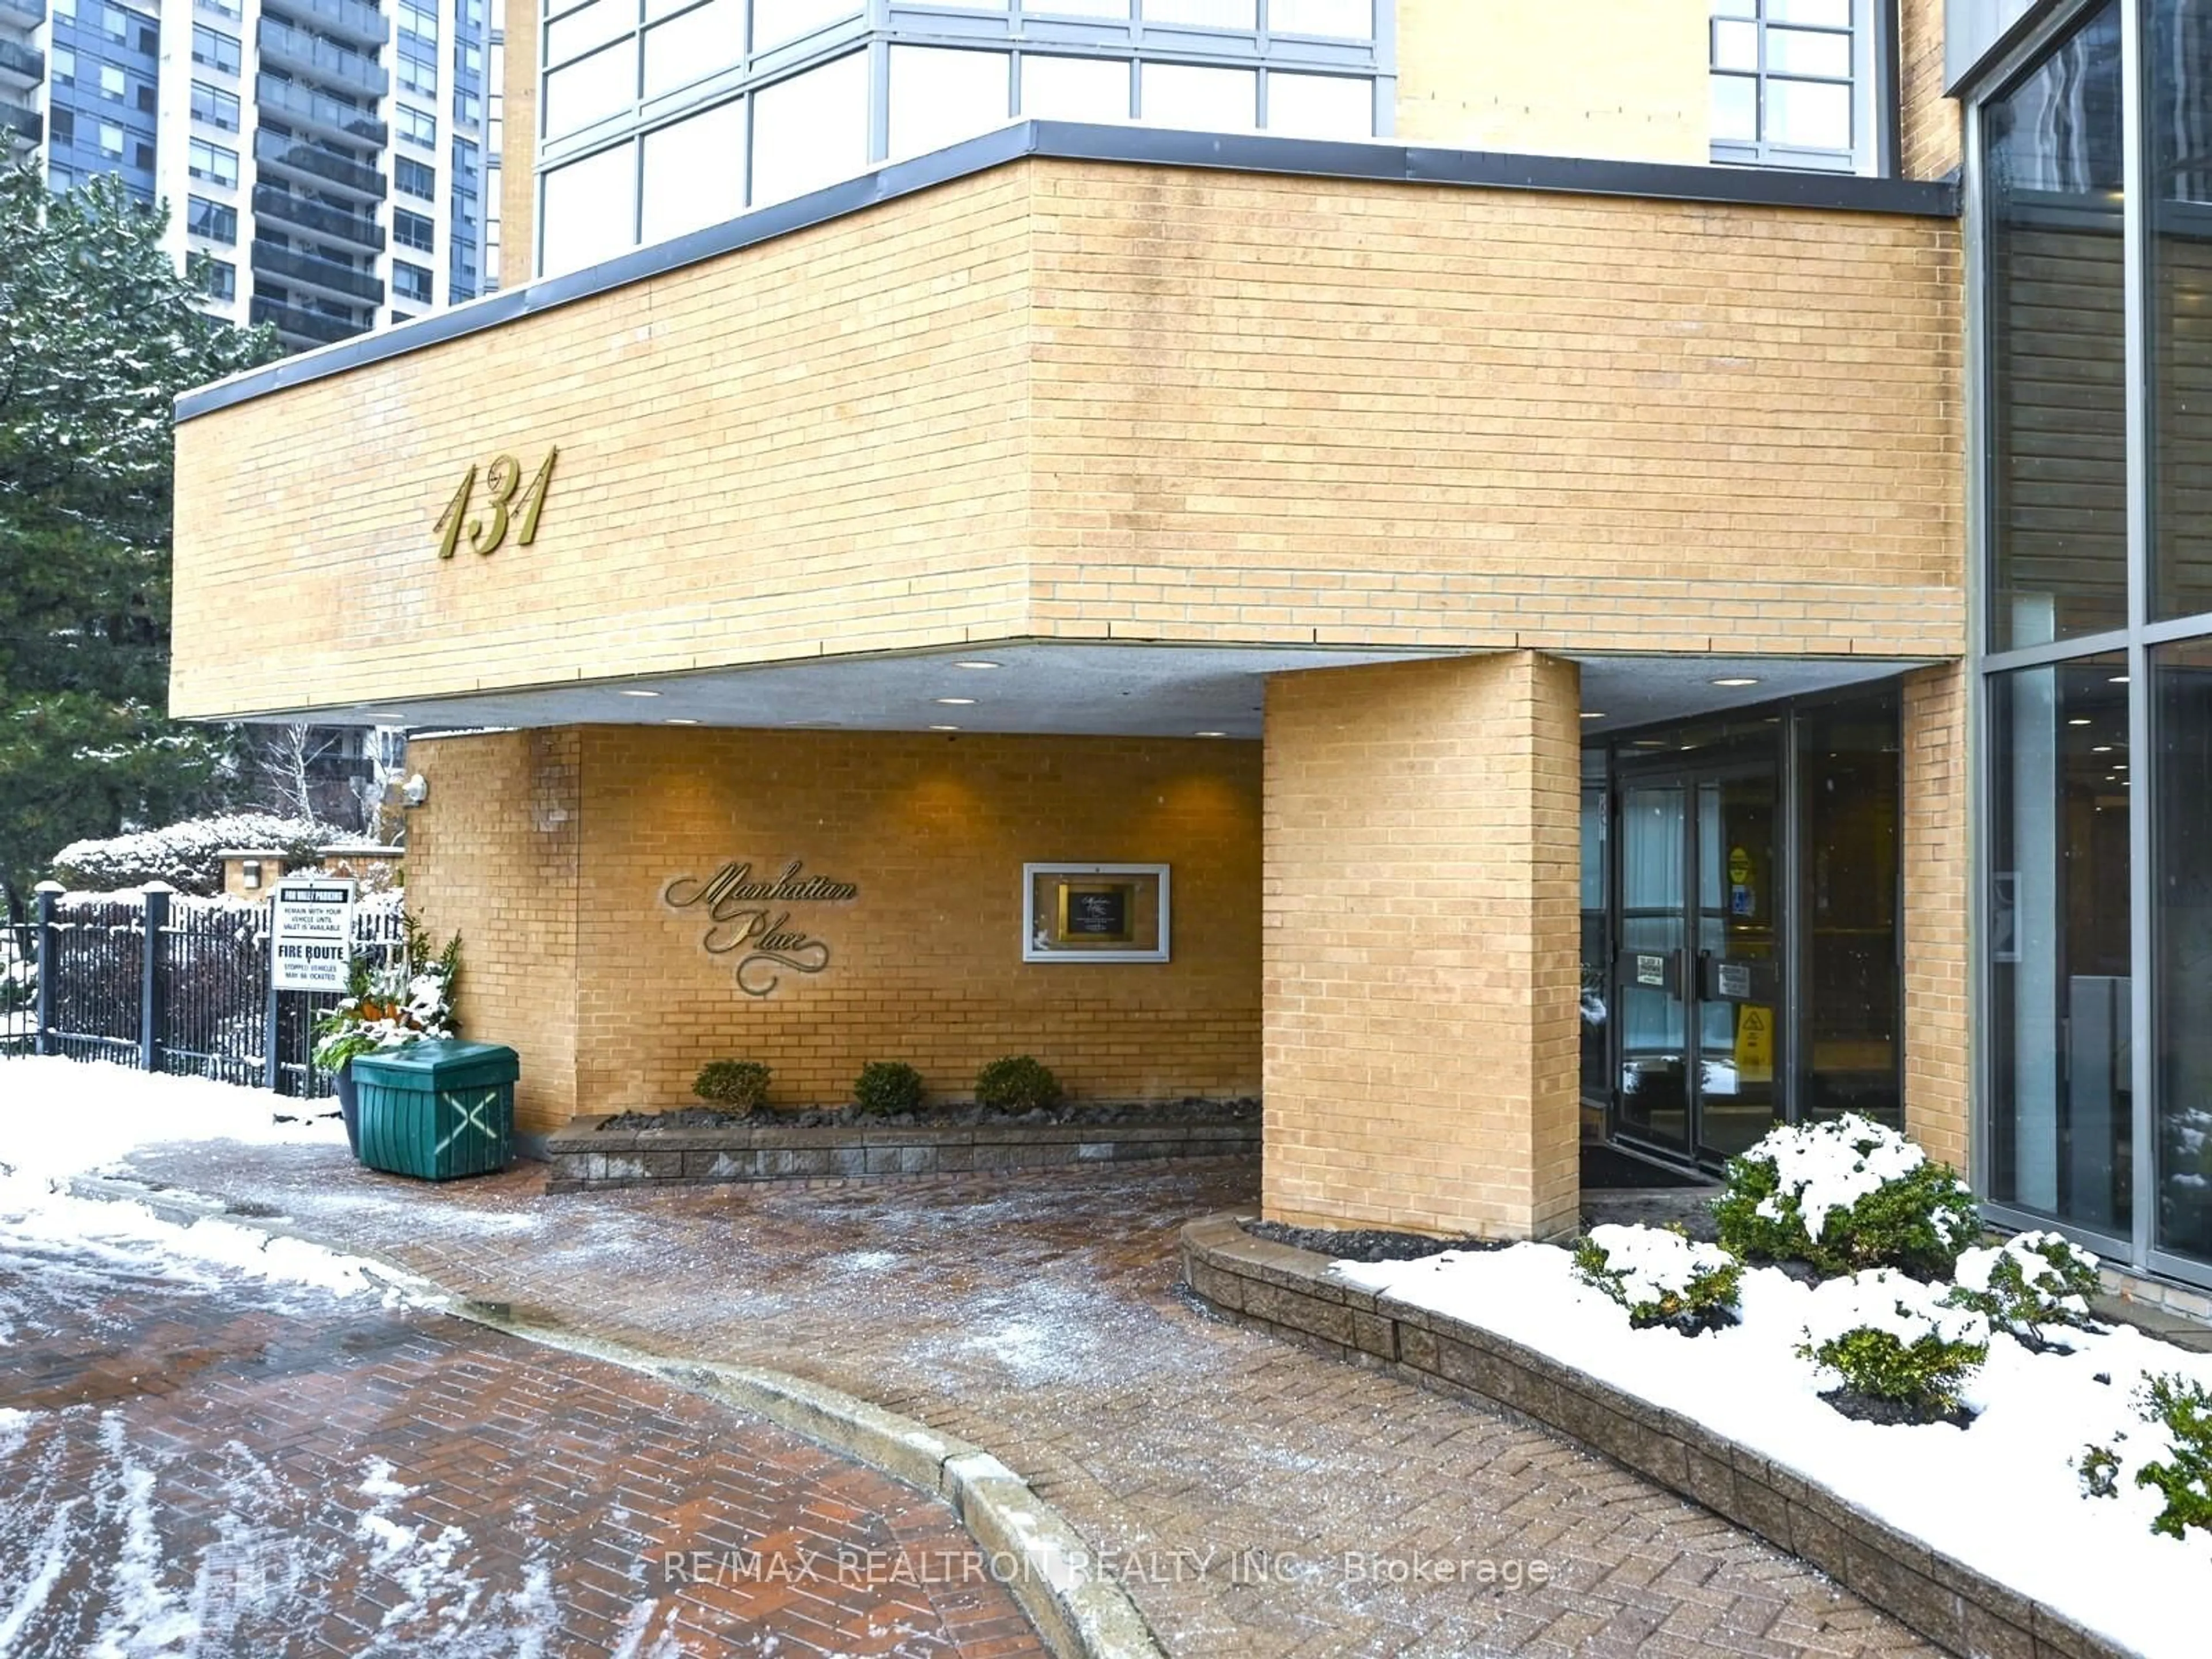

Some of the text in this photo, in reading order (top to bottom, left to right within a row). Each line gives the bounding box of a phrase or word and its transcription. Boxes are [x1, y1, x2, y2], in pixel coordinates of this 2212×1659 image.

[433, 444, 559, 559] 131
[665, 860, 857, 922] Manhattan
[279, 945, 343, 960] FIRE ROUTE
[703, 910, 830, 995] Place
